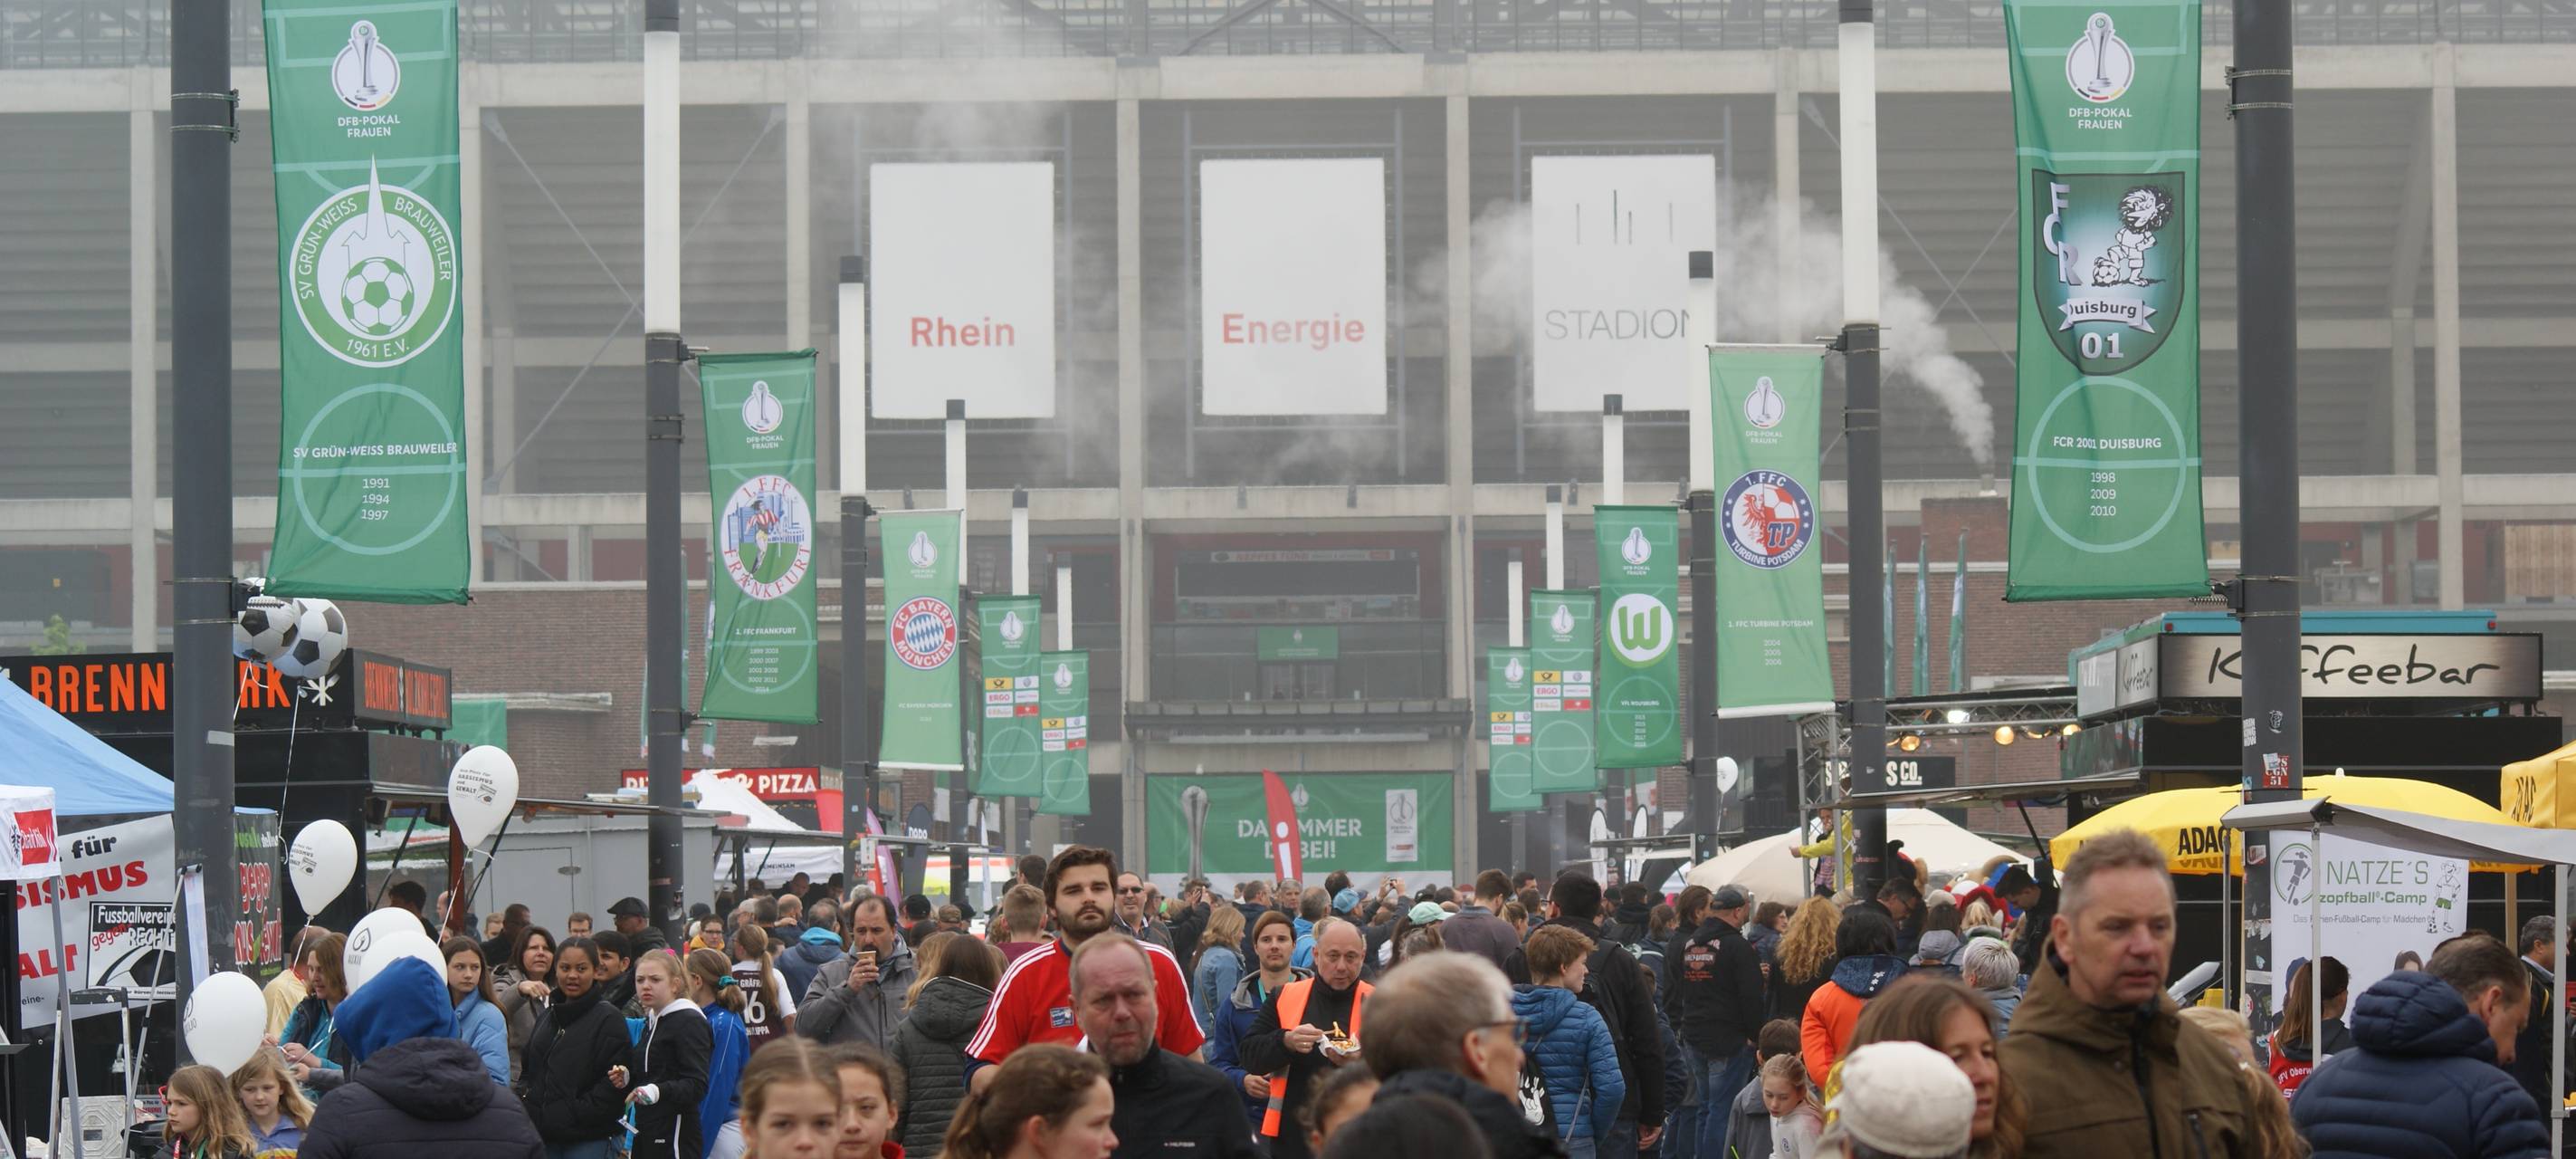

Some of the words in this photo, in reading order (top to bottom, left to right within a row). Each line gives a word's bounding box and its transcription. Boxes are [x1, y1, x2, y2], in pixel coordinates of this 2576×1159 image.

[2069, 108, 2132, 119] DFB-POKAL
[338, 115, 401, 128] DFB-POKAL
[2078, 119, 2123, 129] FRAUEN
[347, 127, 392, 139] FRAUEN
[298, 197, 358, 276] GRÜN-WEISS
[394, 196, 452, 282] BRAUWEILER
[295, 281, 314, 301] SV
[2069, 302, 2137, 318] uisburg
[911, 316, 1015, 347] Rhein
[1223, 312, 1365, 351] Energie
[347, 339, 377, 359] 1961
[384, 339, 410, 358] E.V.
[2081, 331, 2124, 359] 01
[293, 447, 310, 458] SV
[311, 445, 384, 458] GRÜN-WEISS
[387, 442, 458, 455] BRAUWEILER
[2053, 436, 2074, 447] FCR
[2076, 437, 2097, 449] 2001
[2099, 437, 2162, 449] DUISBURG
[362, 478, 391, 489] 1991
[1759, 472, 1787, 487] FFC
[2090, 472, 2116, 483] 1998
[362, 493, 390, 504] 1994
[2090, 488, 2116, 500] 2009
[361, 509, 389, 521] 1997
[2090, 505, 2116, 516] 2010
[1731, 539, 1767, 565] TURBINE
[1768, 539, 1805, 565] POTSDAM
[723, 544, 811, 599] FRANKFURT
[895, 613, 909, 629] FC
[909, 600, 953, 629] BAYERN
[1781, 619, 1814, 627] POTSDAM
[755, 627, 797, 635] FRANKFURT
[988, 694, 1010, 702] ERGO
[1536, 687, 1558, 695] ERGO
[1900, 761, 1922, 781] CO.
[758, 774, 818, 793] PIZZA
[2270, 776, 2282, 786] 51
[1237, 819, 1270, 838] DA
[71, 836, 117, 859] für
[741, 991, 766, 1024] 16
